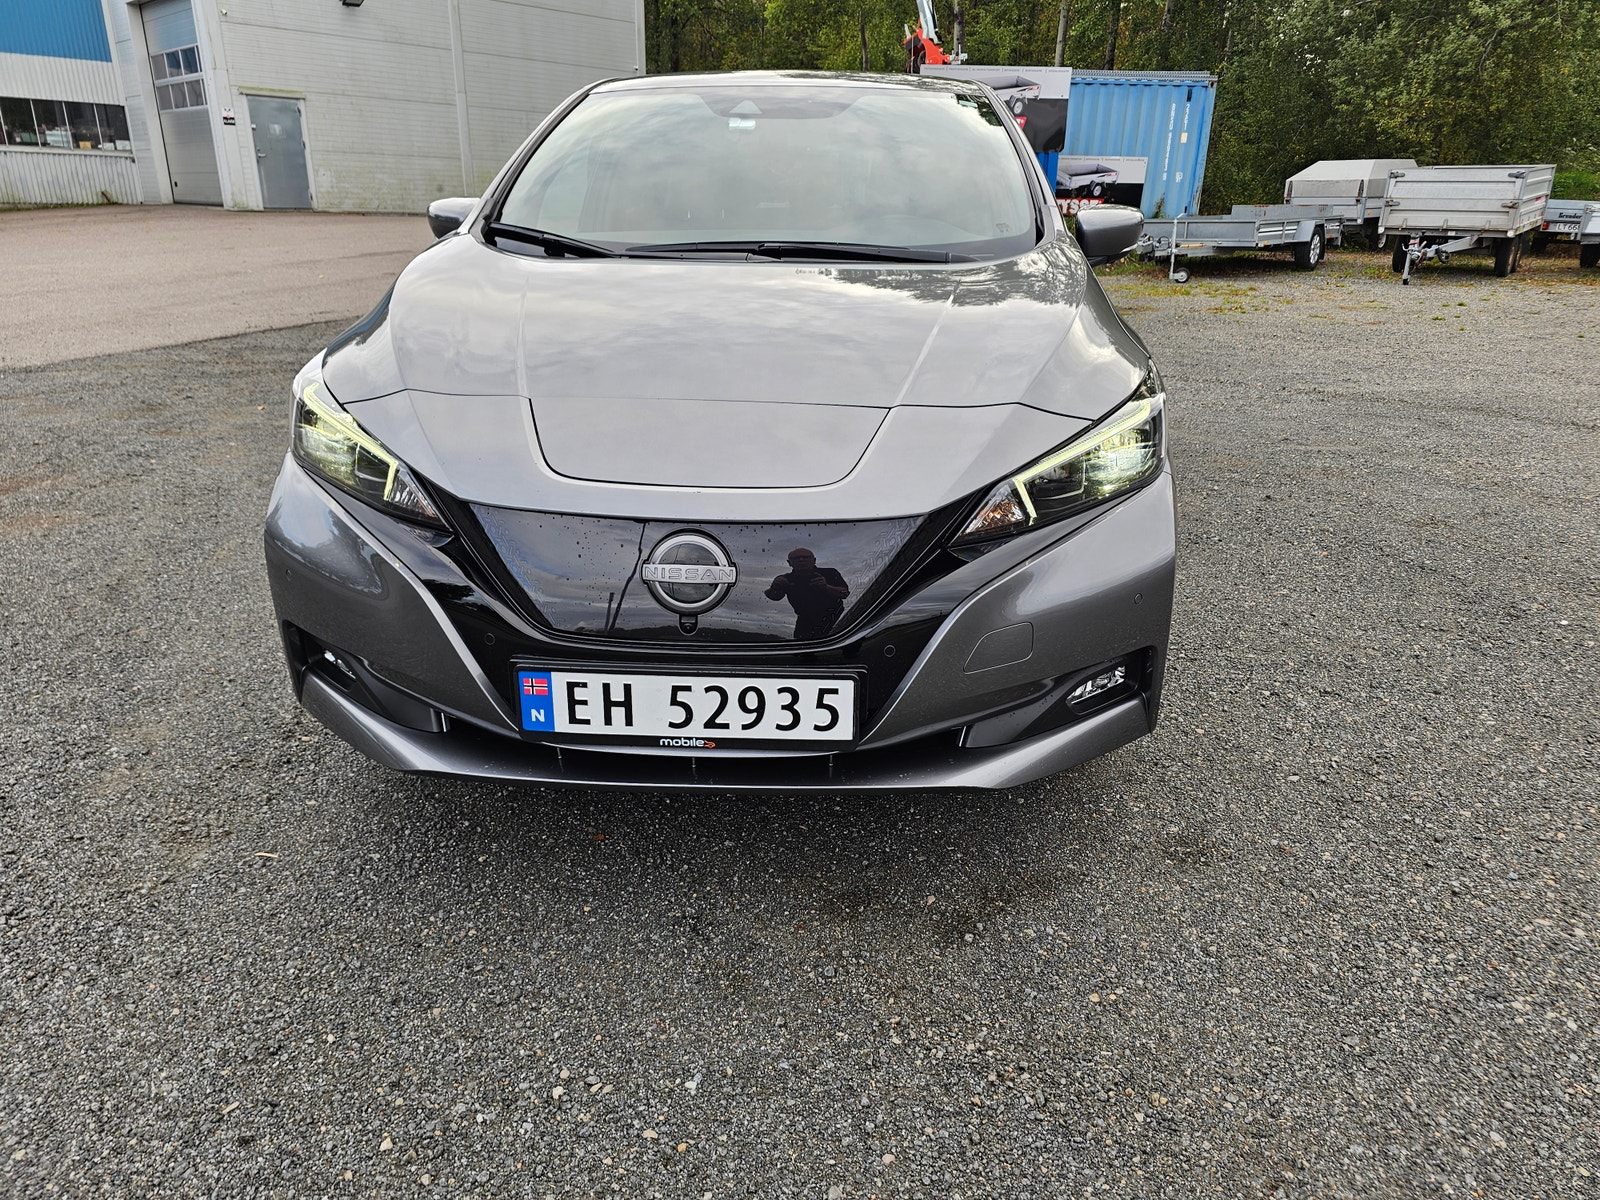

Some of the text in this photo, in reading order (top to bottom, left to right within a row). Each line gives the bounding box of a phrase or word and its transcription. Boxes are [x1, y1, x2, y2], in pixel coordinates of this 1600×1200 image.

[644, 566, 734, 581] NISSAN
[565, 681, 840, 732] EH 52935
[531, 709, 545, 722] N
[659, 737, 705, 747] mobile
